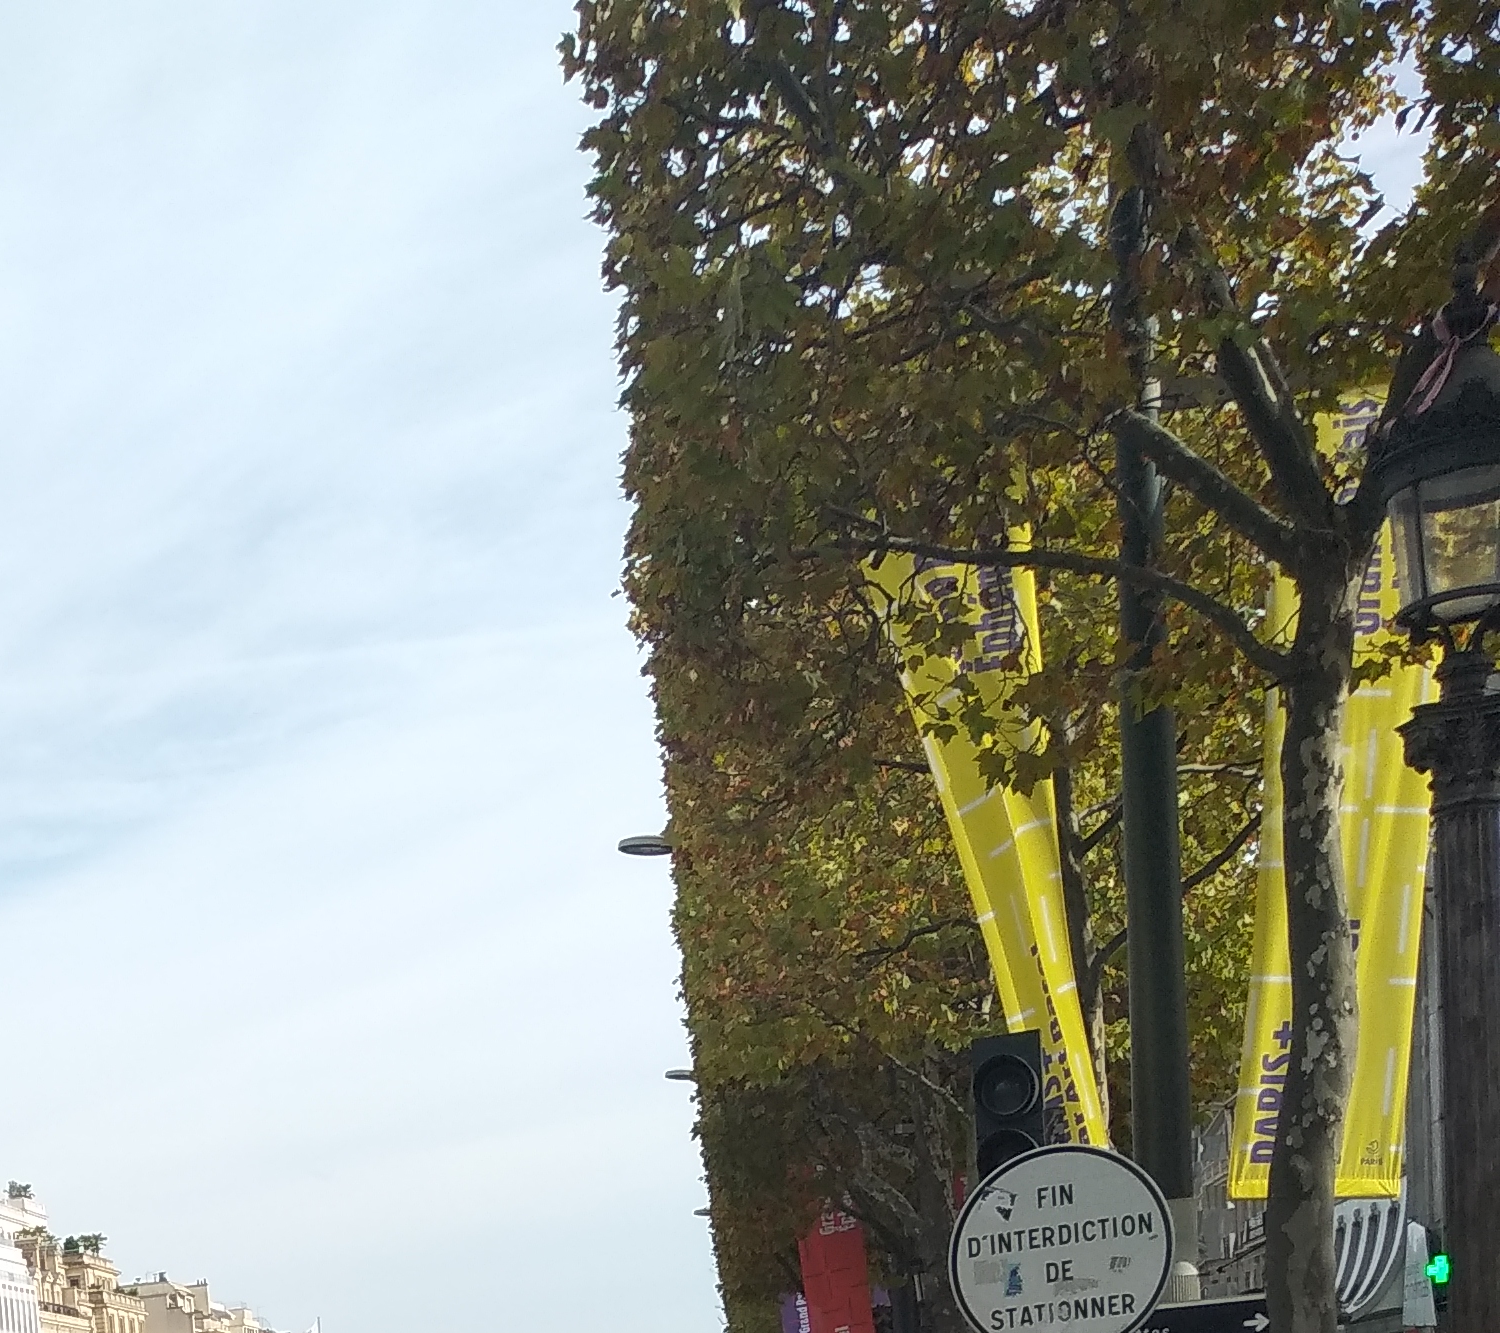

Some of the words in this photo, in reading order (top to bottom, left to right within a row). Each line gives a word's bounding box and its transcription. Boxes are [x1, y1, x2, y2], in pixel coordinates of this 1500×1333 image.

[1036, 1183, 1074, 1209] FIN
[967, 1211, 1154, 1259] D'INTERDICTION
[1046, 1259, 1074, 1284] DE
[990, 1293, 1136, 1331] STATIONNER
